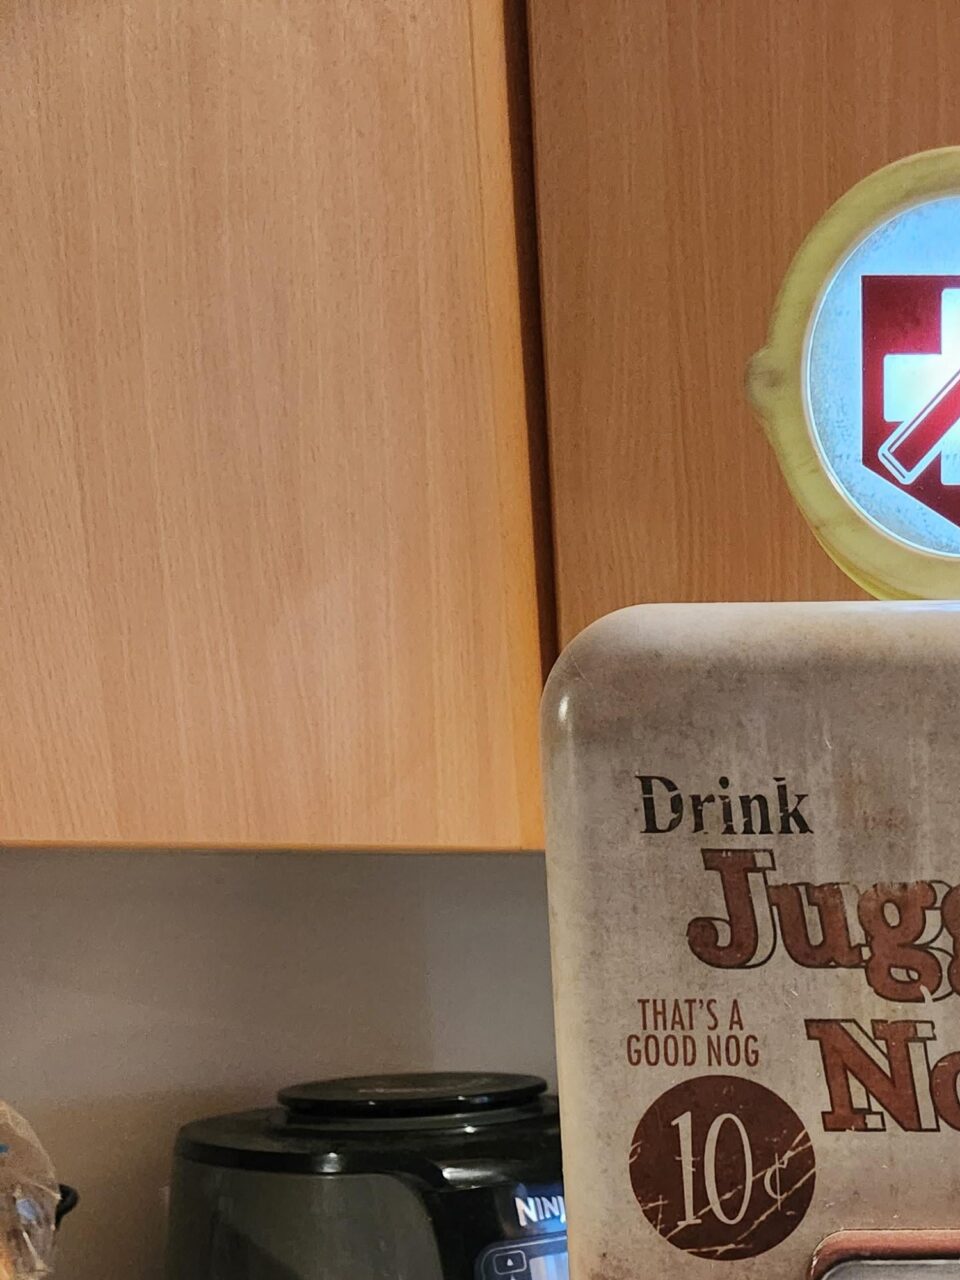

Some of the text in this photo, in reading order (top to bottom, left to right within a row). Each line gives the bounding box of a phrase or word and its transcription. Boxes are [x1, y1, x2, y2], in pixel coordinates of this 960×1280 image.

[635, 774, 815, 835] Drink
[637, 998, 745, 1032] THAT'S A
[626, 1034, 760, 1068] GOOD NOG
